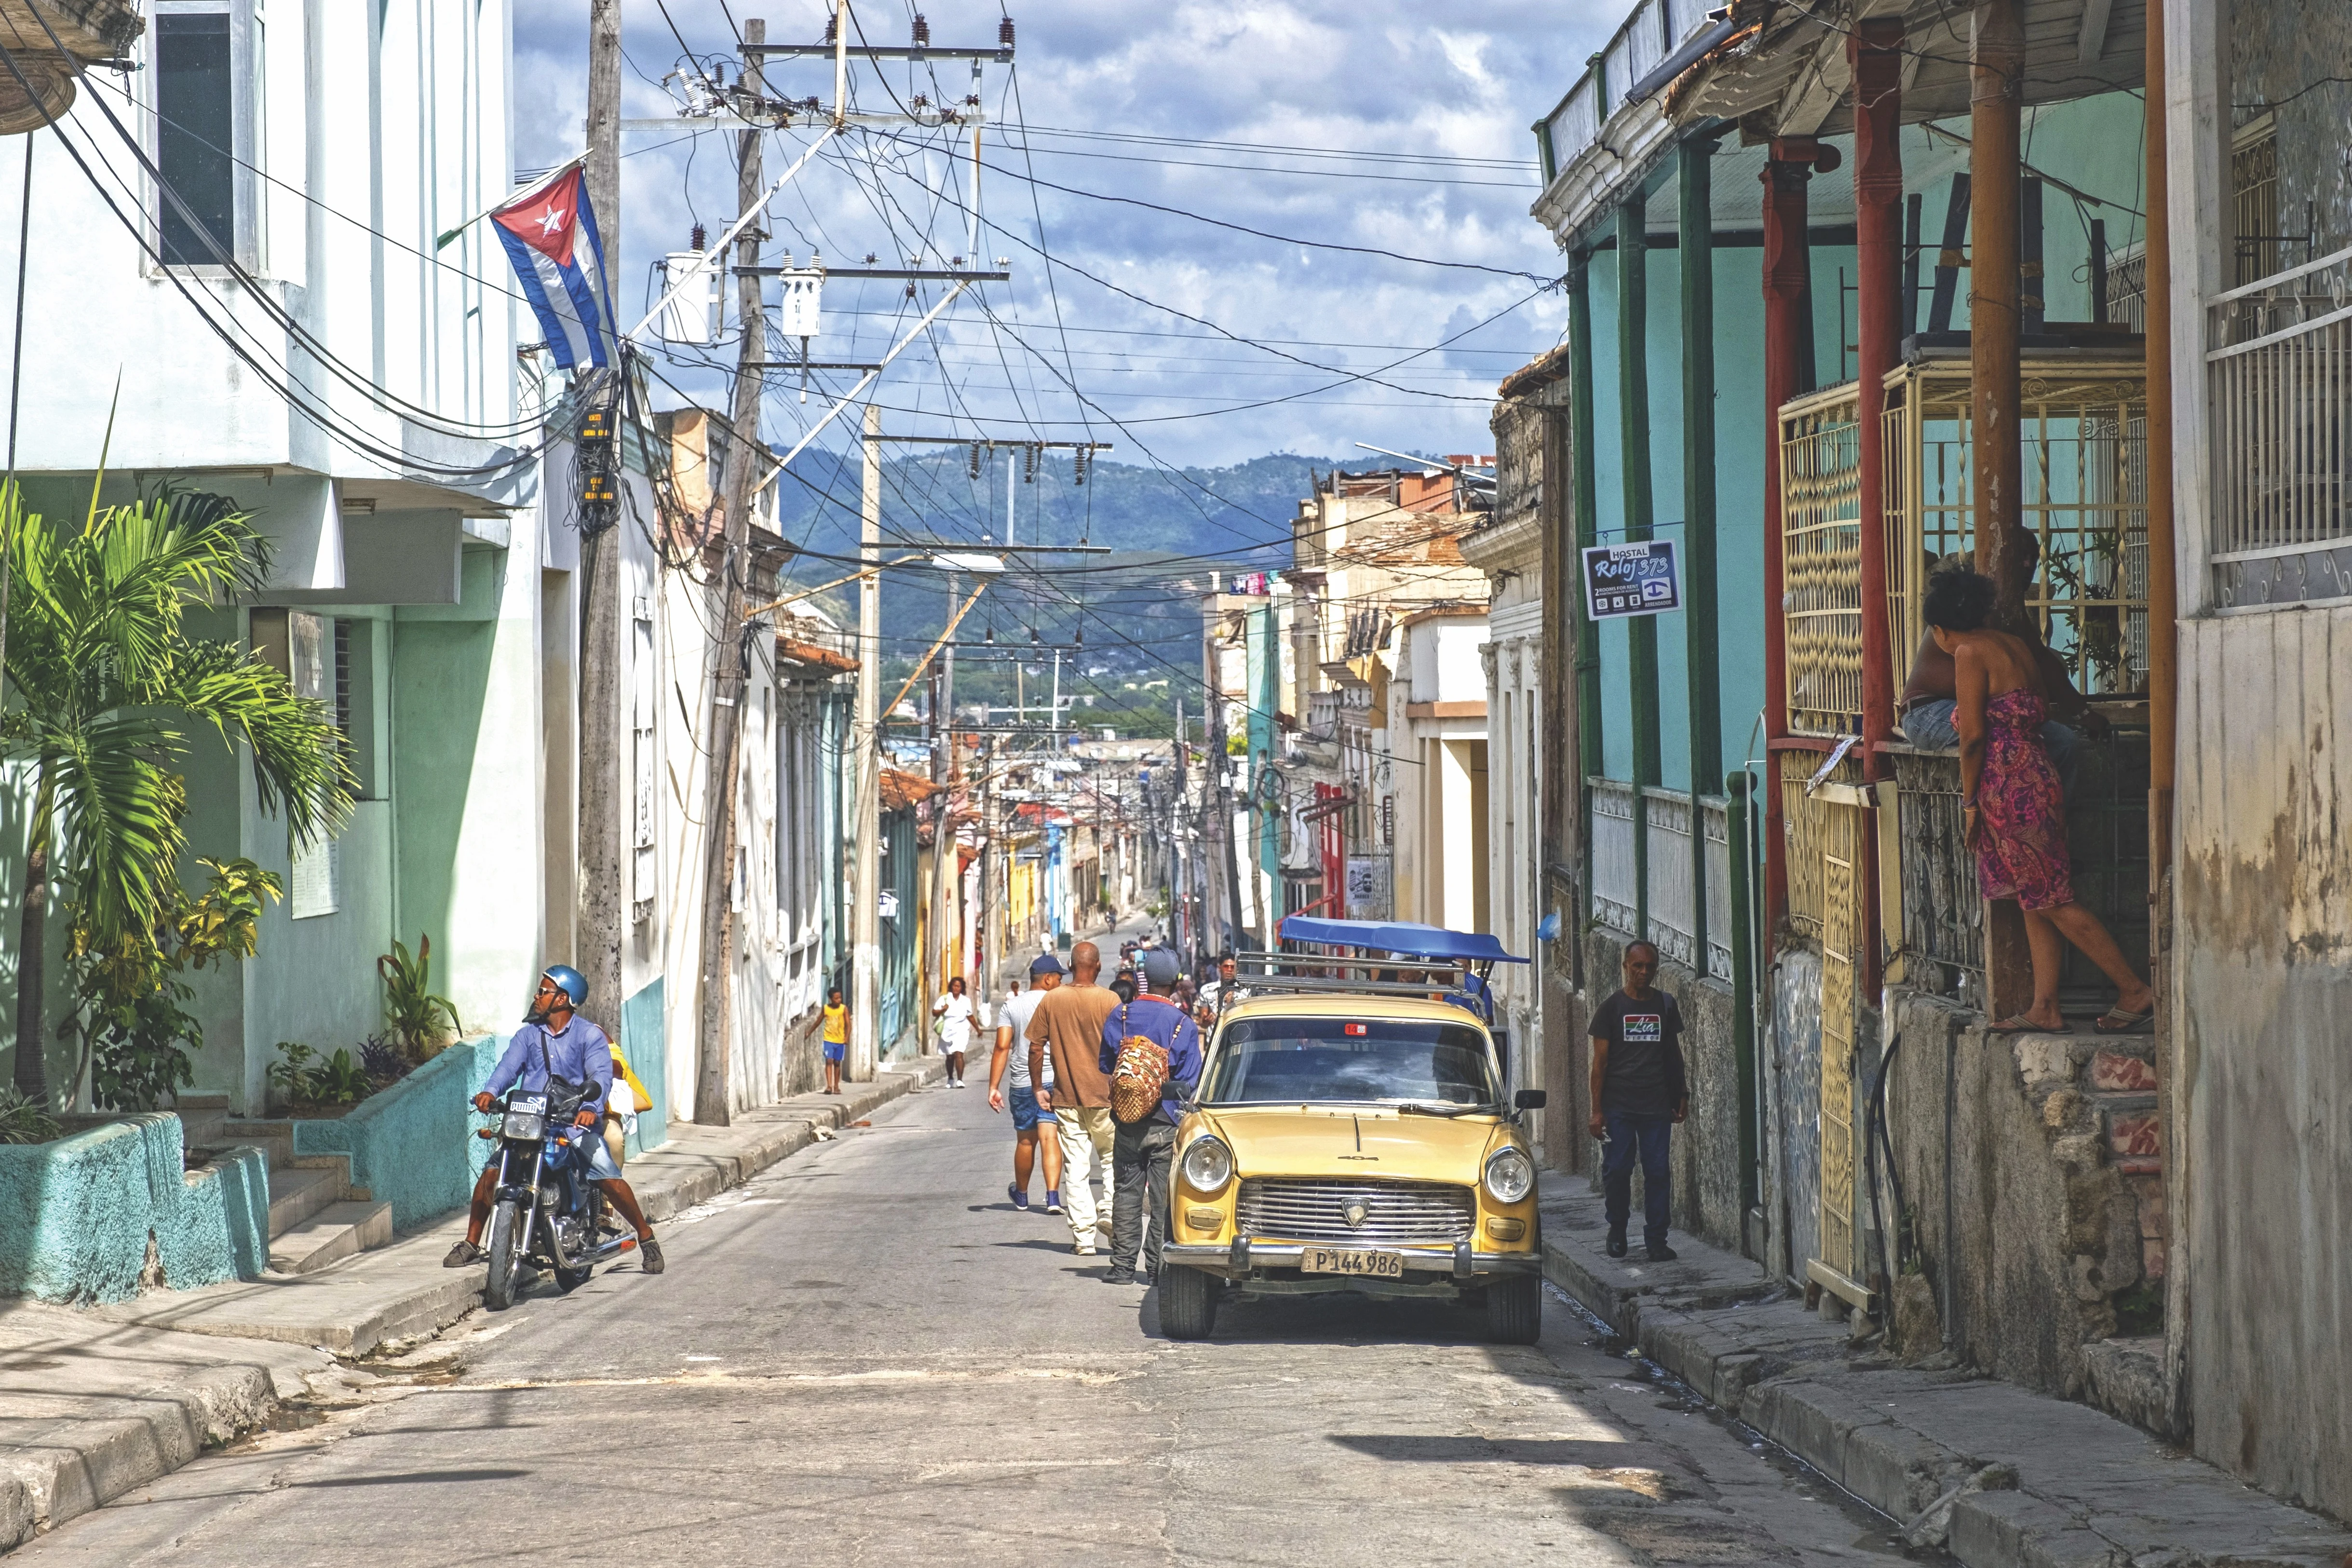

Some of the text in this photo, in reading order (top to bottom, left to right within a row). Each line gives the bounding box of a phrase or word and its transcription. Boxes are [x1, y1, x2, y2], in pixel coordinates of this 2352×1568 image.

[1613, 549, 1648, 559] HOSTAL
[1595, 556, 1668, 582] Reloj 373
[1347, 1025, 1357, 1034] 14
[1630, 1017, 1655, 1033] Lía
[512, 1103, 536, 1112] PUMA
